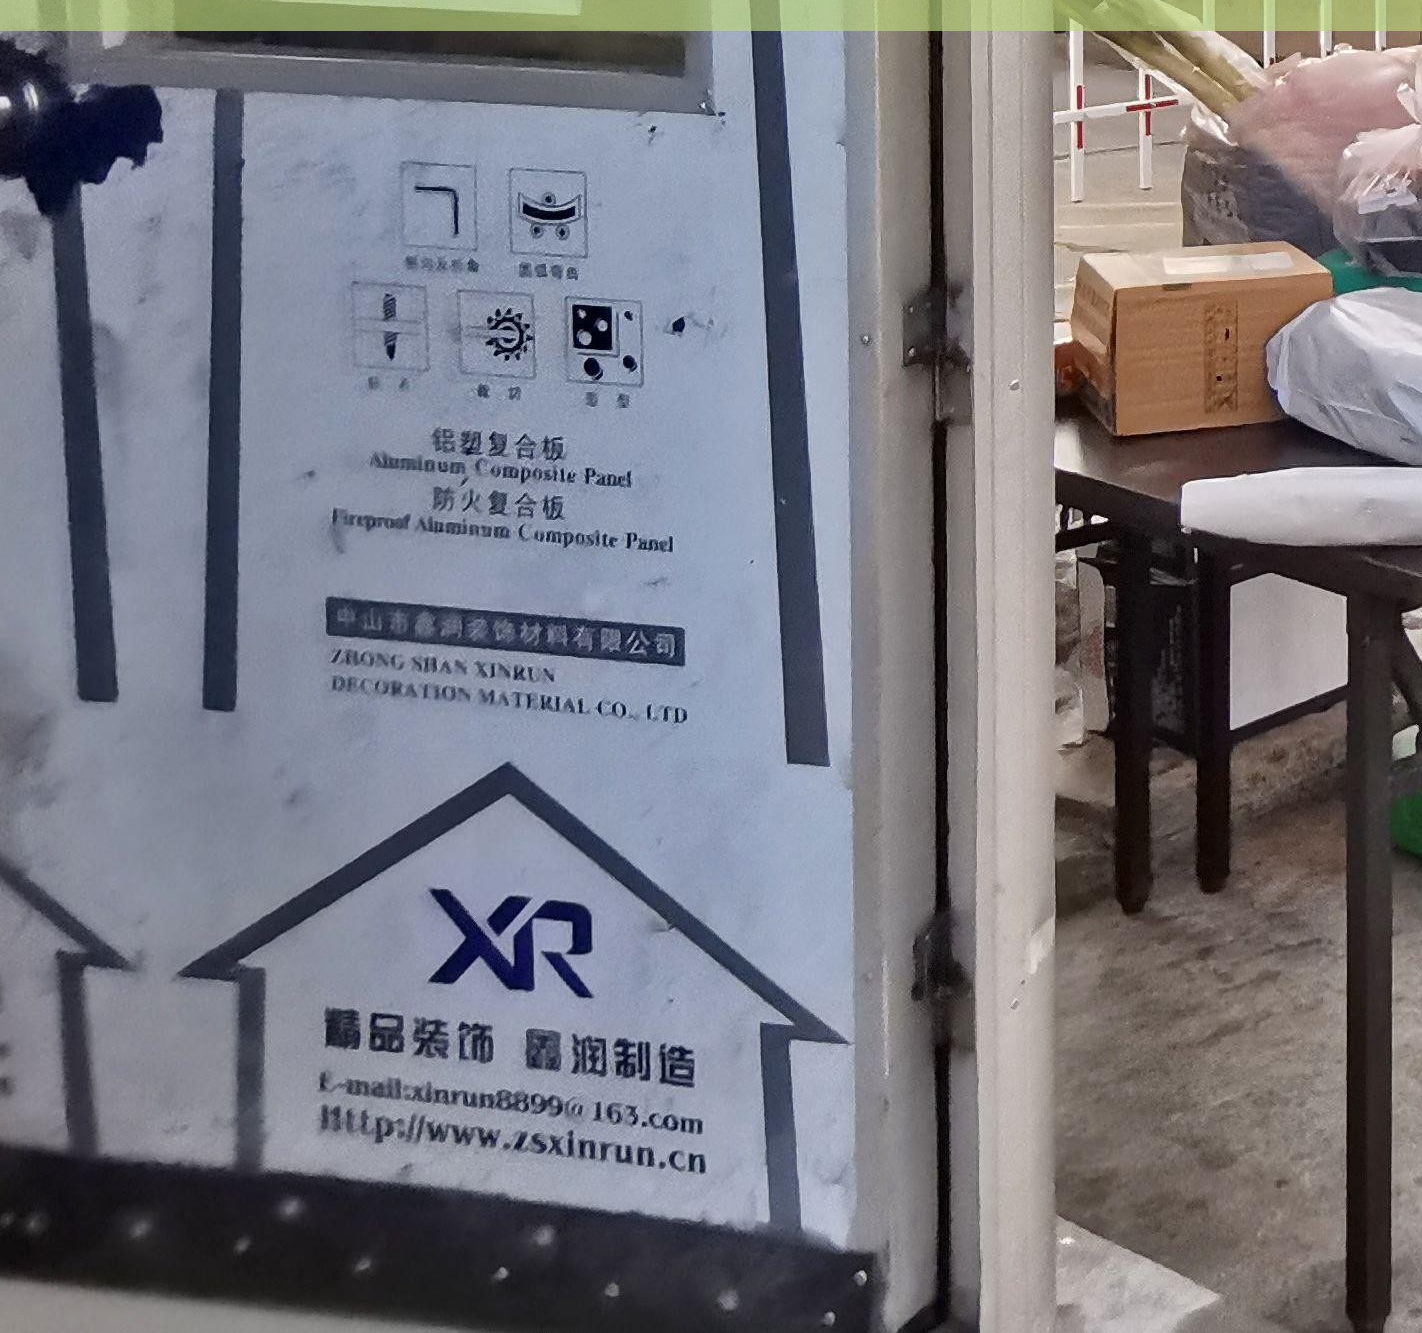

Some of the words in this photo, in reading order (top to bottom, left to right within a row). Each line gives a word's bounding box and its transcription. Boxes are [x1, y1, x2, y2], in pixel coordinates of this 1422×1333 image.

[431, 427, 566, 462] 铝塑复合板
[370, 450, 466, 475] Aluminum
[474, 458, 577, 483] Composite
[584, 467, 633, 488] Panel
[432, 486, 566, 520] 防火复合板
[332, 508, 411, 531] Fireproof
[416, 516, 511, 539] Aluminum
[517, 523, 618, 549] Composite
[625, 531, 674, 553] Panel
[330, 649, 404, 671] ZHONG
[411, 656, 467, 675] SHAN
[474, 661, 555, 683] XINRUN
[331, 675, 471, 702] DECORATION
[478, 688, 589, 715] MATERIAL
[646, 703, 688, 724] LTD
[428, 888, 593, 998] XR
[325, 1008, 494, 1064] 精品装饰
[320, 1104, 707, 1175] Http://www.zsxinrun.cn
